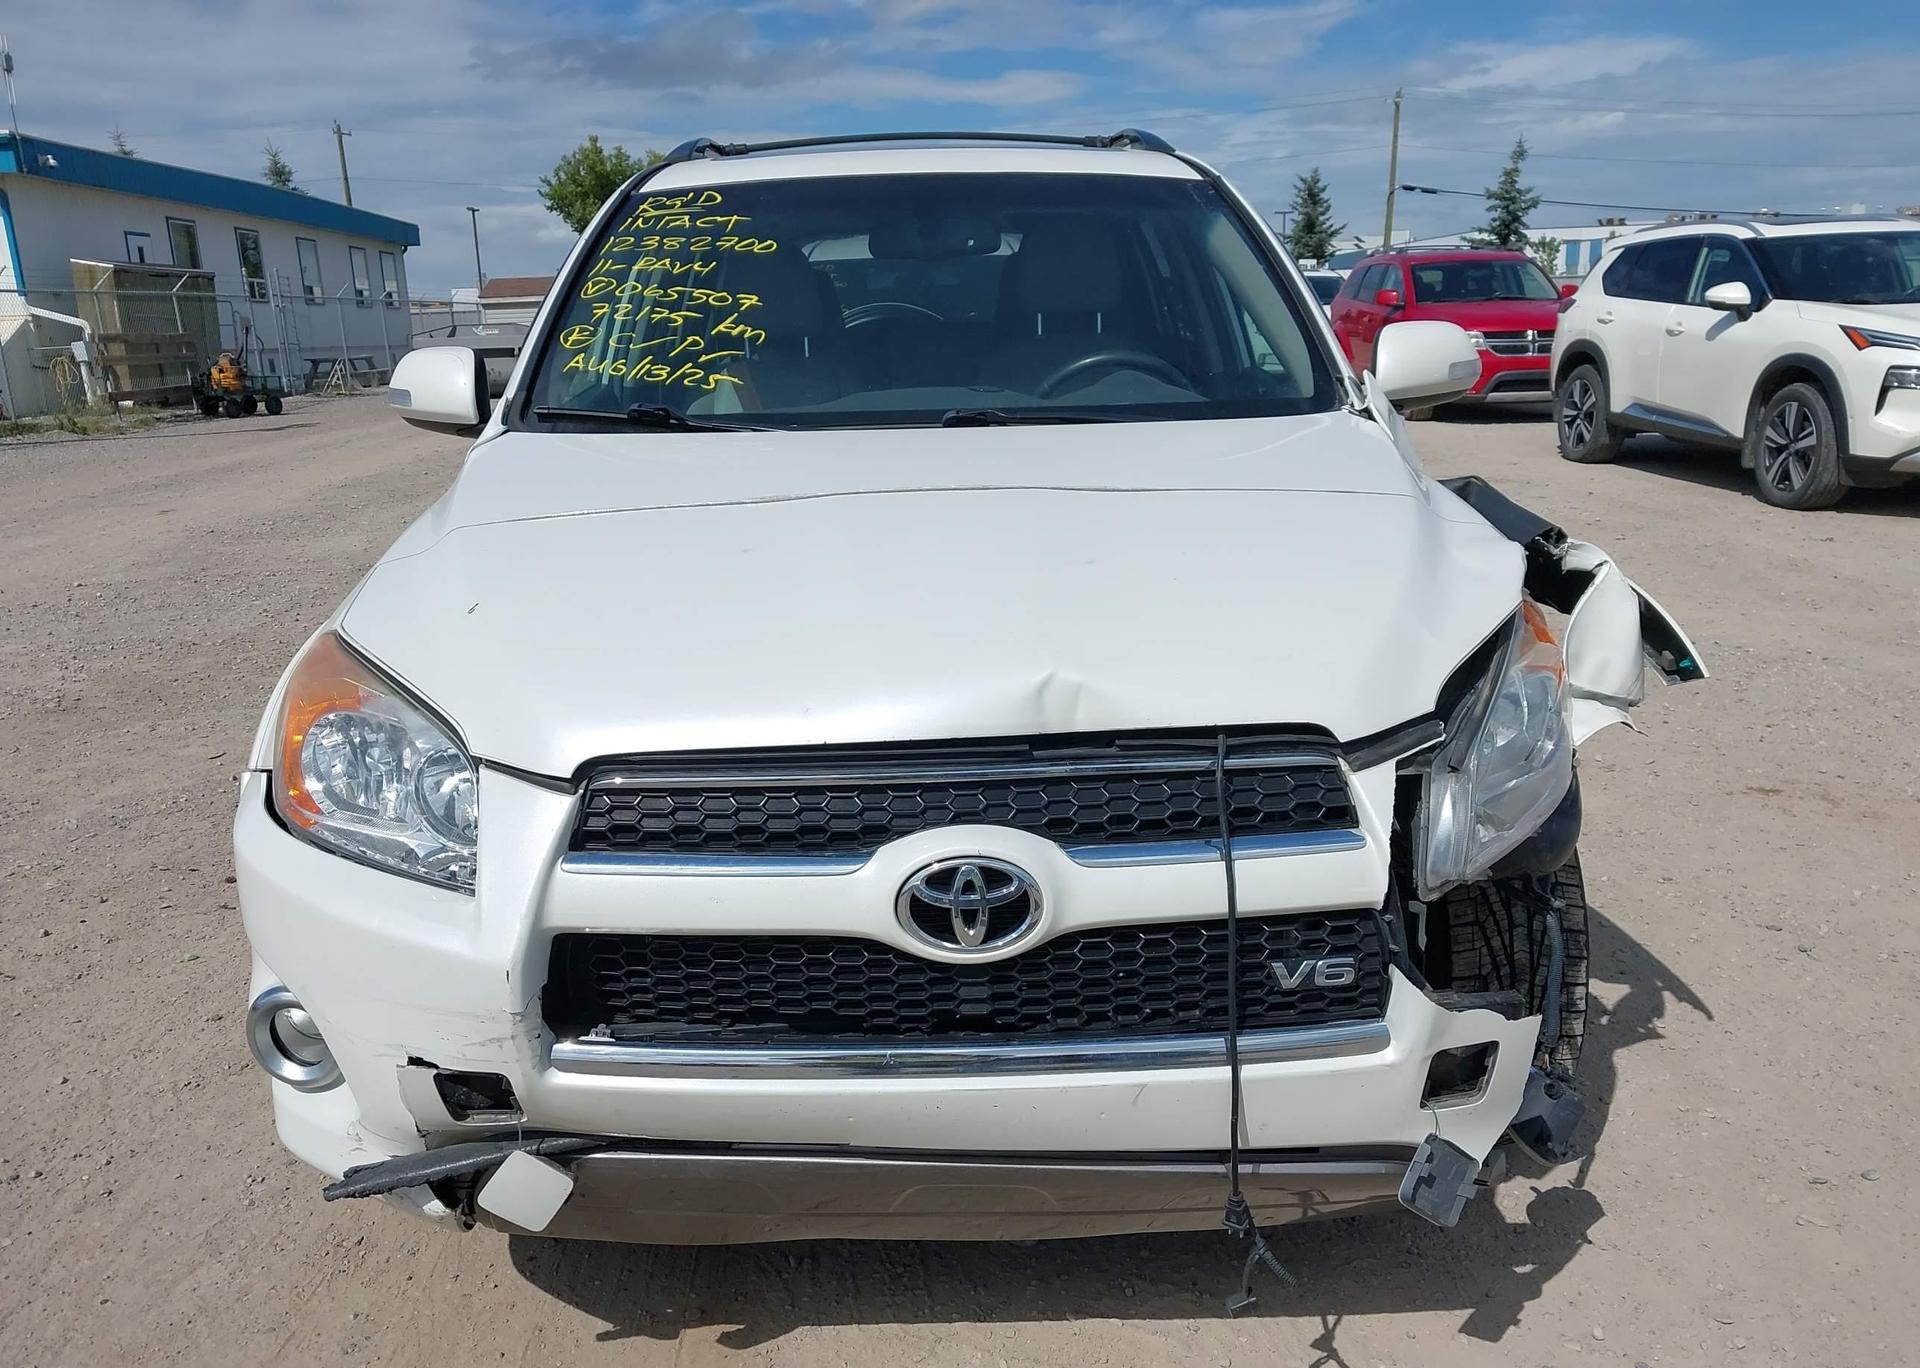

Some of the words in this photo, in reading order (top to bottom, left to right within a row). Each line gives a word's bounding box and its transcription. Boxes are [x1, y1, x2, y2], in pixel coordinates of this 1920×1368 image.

[618, 215, 752, 232] INTACT
[600, 235, 777, 256] 12382700
[1271, 957, 1356, 991] V6
